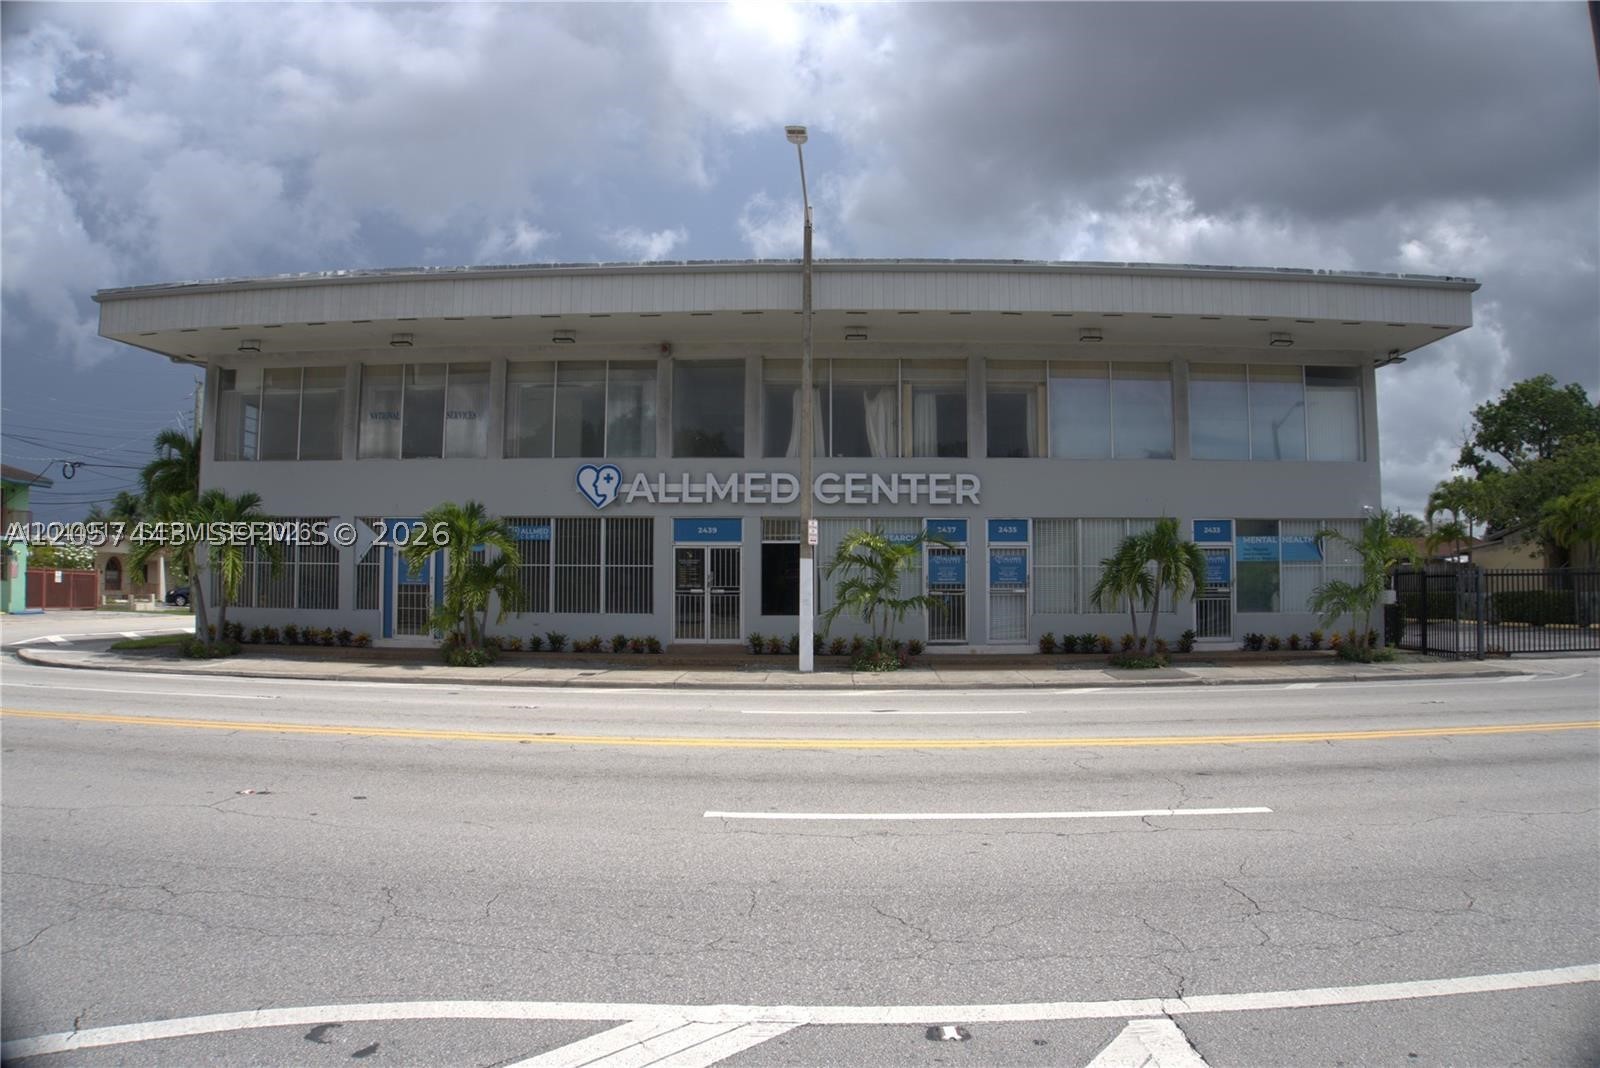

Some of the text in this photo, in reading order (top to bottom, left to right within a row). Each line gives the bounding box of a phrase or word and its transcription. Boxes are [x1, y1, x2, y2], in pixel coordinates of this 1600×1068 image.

[625, 472, 981, 505] ALLMED CENTER
[520, 527, 549, 535] ALLMED
[1242, 536, 1315, 544] MENTAL HEALTH
